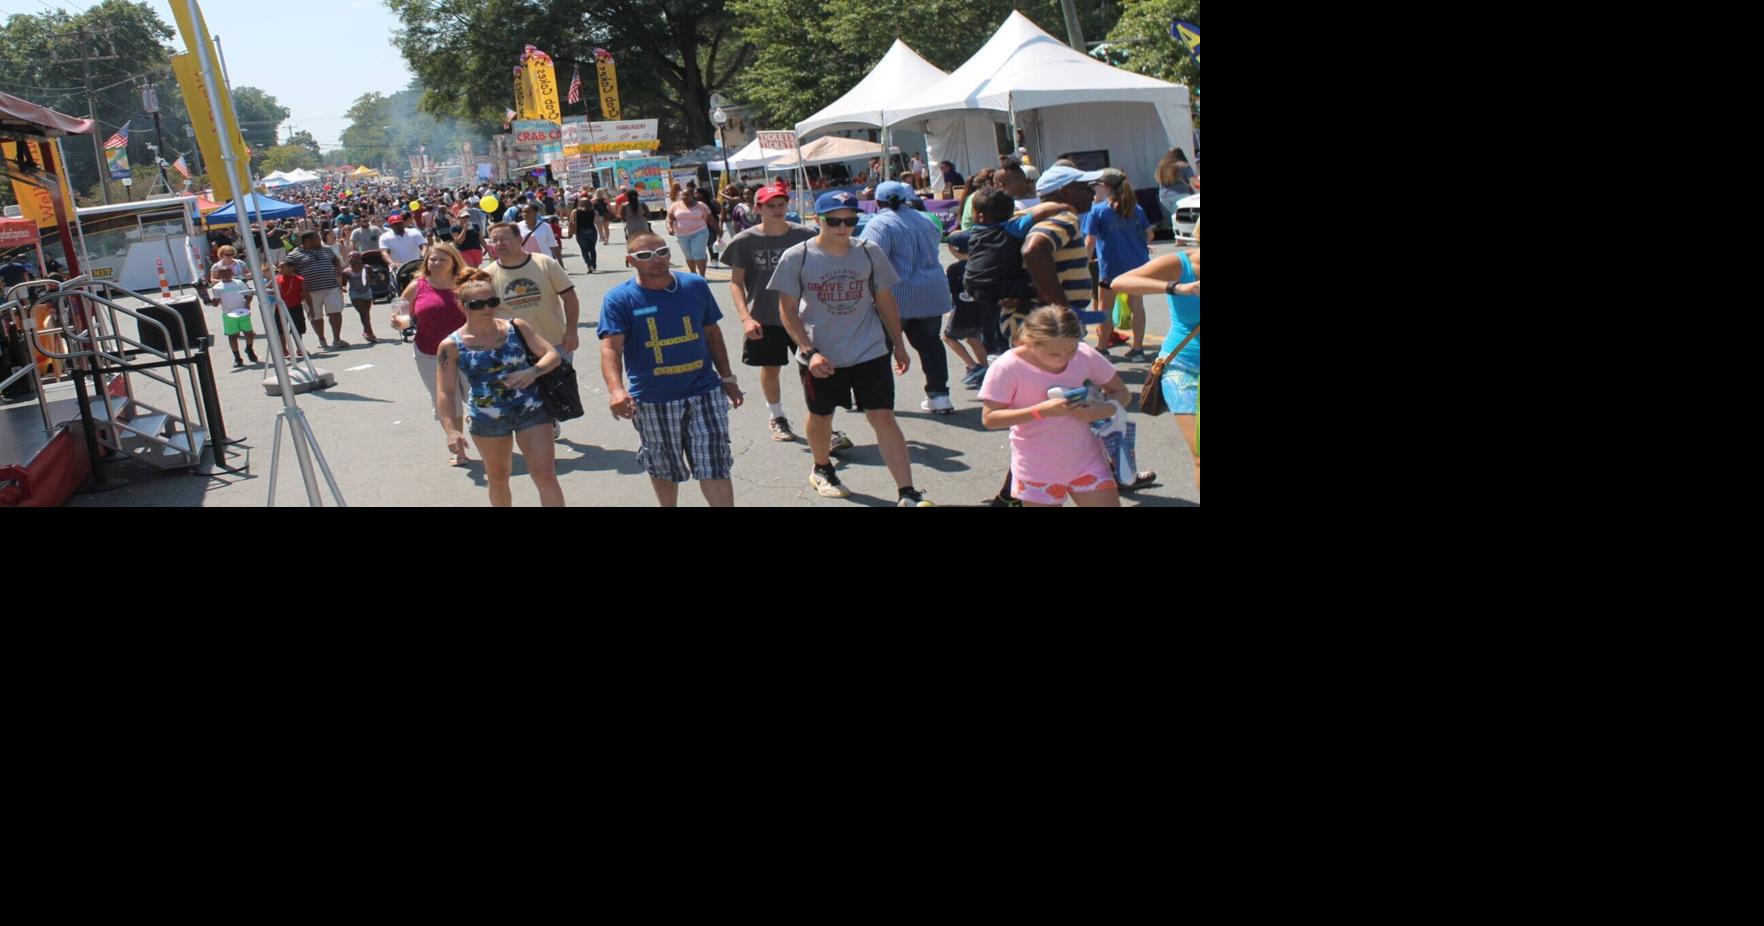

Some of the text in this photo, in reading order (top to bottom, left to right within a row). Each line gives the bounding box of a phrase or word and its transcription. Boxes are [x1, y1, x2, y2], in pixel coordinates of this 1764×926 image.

[517, 131, 546, 141] CRAB
[807, 282, 844, 292] GROVE
[817, 290, 864, 301] COLLEGE
